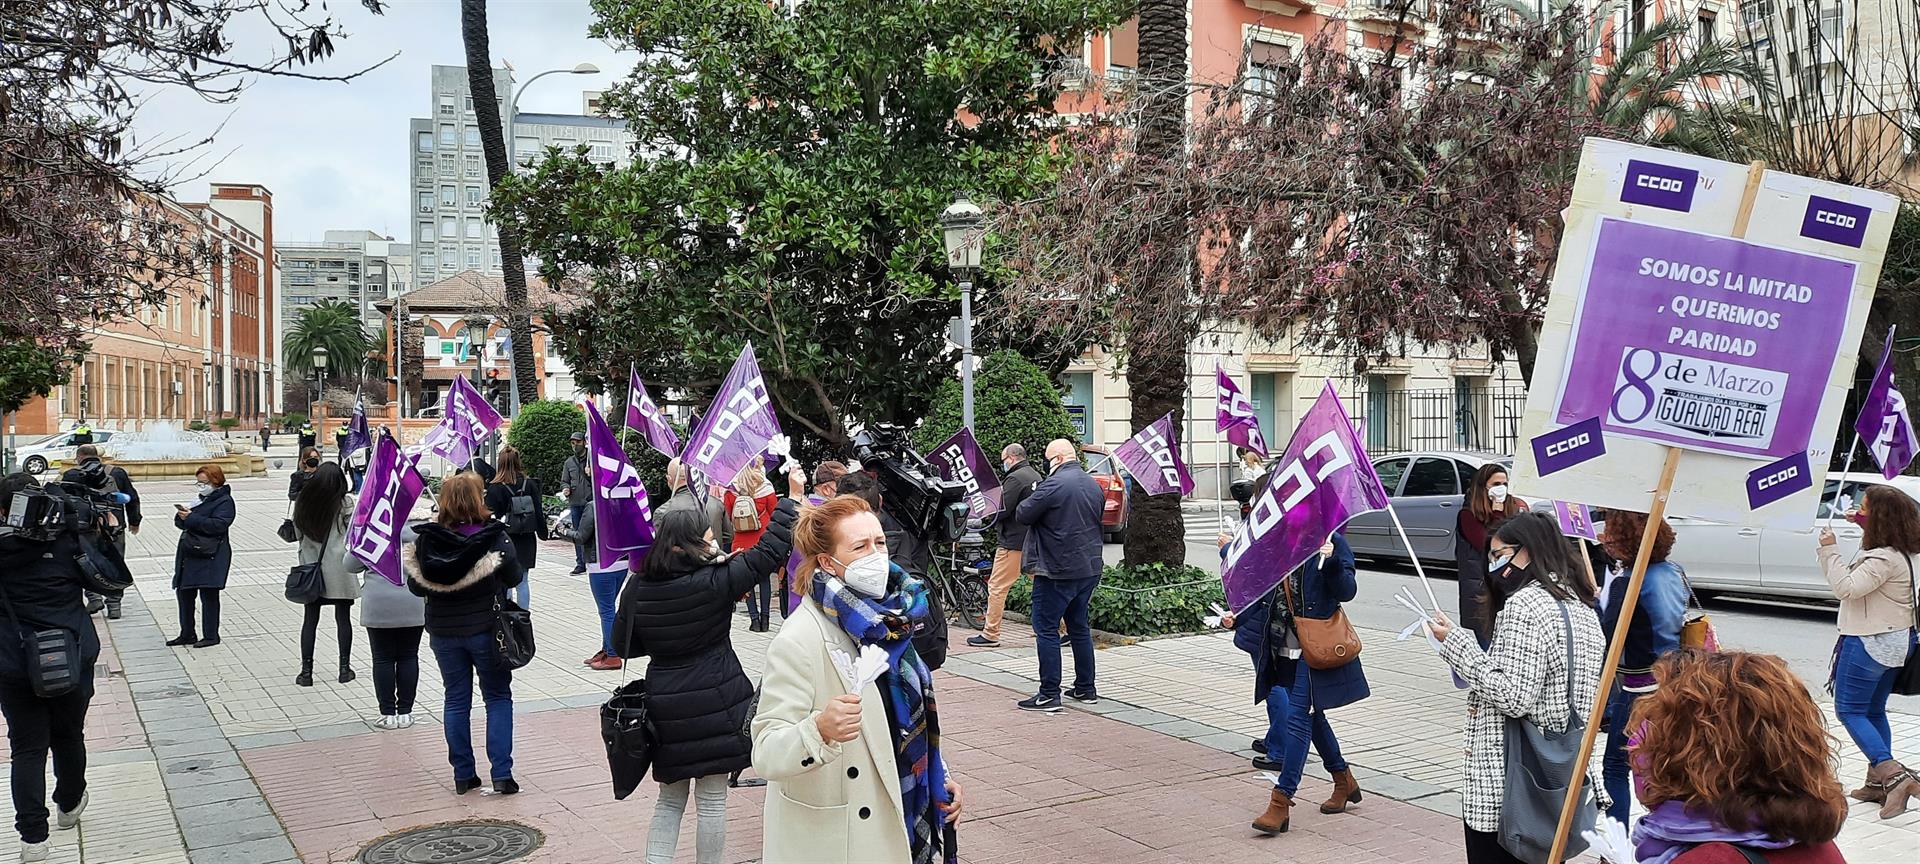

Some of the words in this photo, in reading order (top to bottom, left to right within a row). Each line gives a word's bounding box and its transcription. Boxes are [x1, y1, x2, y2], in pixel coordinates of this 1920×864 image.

[1636, 174, 1683, 193] CCOO
[1816, 210, 1856, 228] CCOO
[1638, 257, 1720, 287] SOMOS
[1723, 272, 1744, 292] LA
[1748, 277, 1812, 303] MITAD
[1671, 295, 1781, 330] QUEREMOS
[1668, 326, 1757, 357] PARIDAD
[1611, 348, 1662, 424] 8
[1664, 359, 1698, 384] de
[1704, 365, 1773, 396] Marzo
[1655, 396, 1731, 431] IGUALDAD
[1733, 408, 1766, 436] REAL
[1545, 432, 1591, 458] CCOO
[1757, 465, 1798, 491] CCOO
